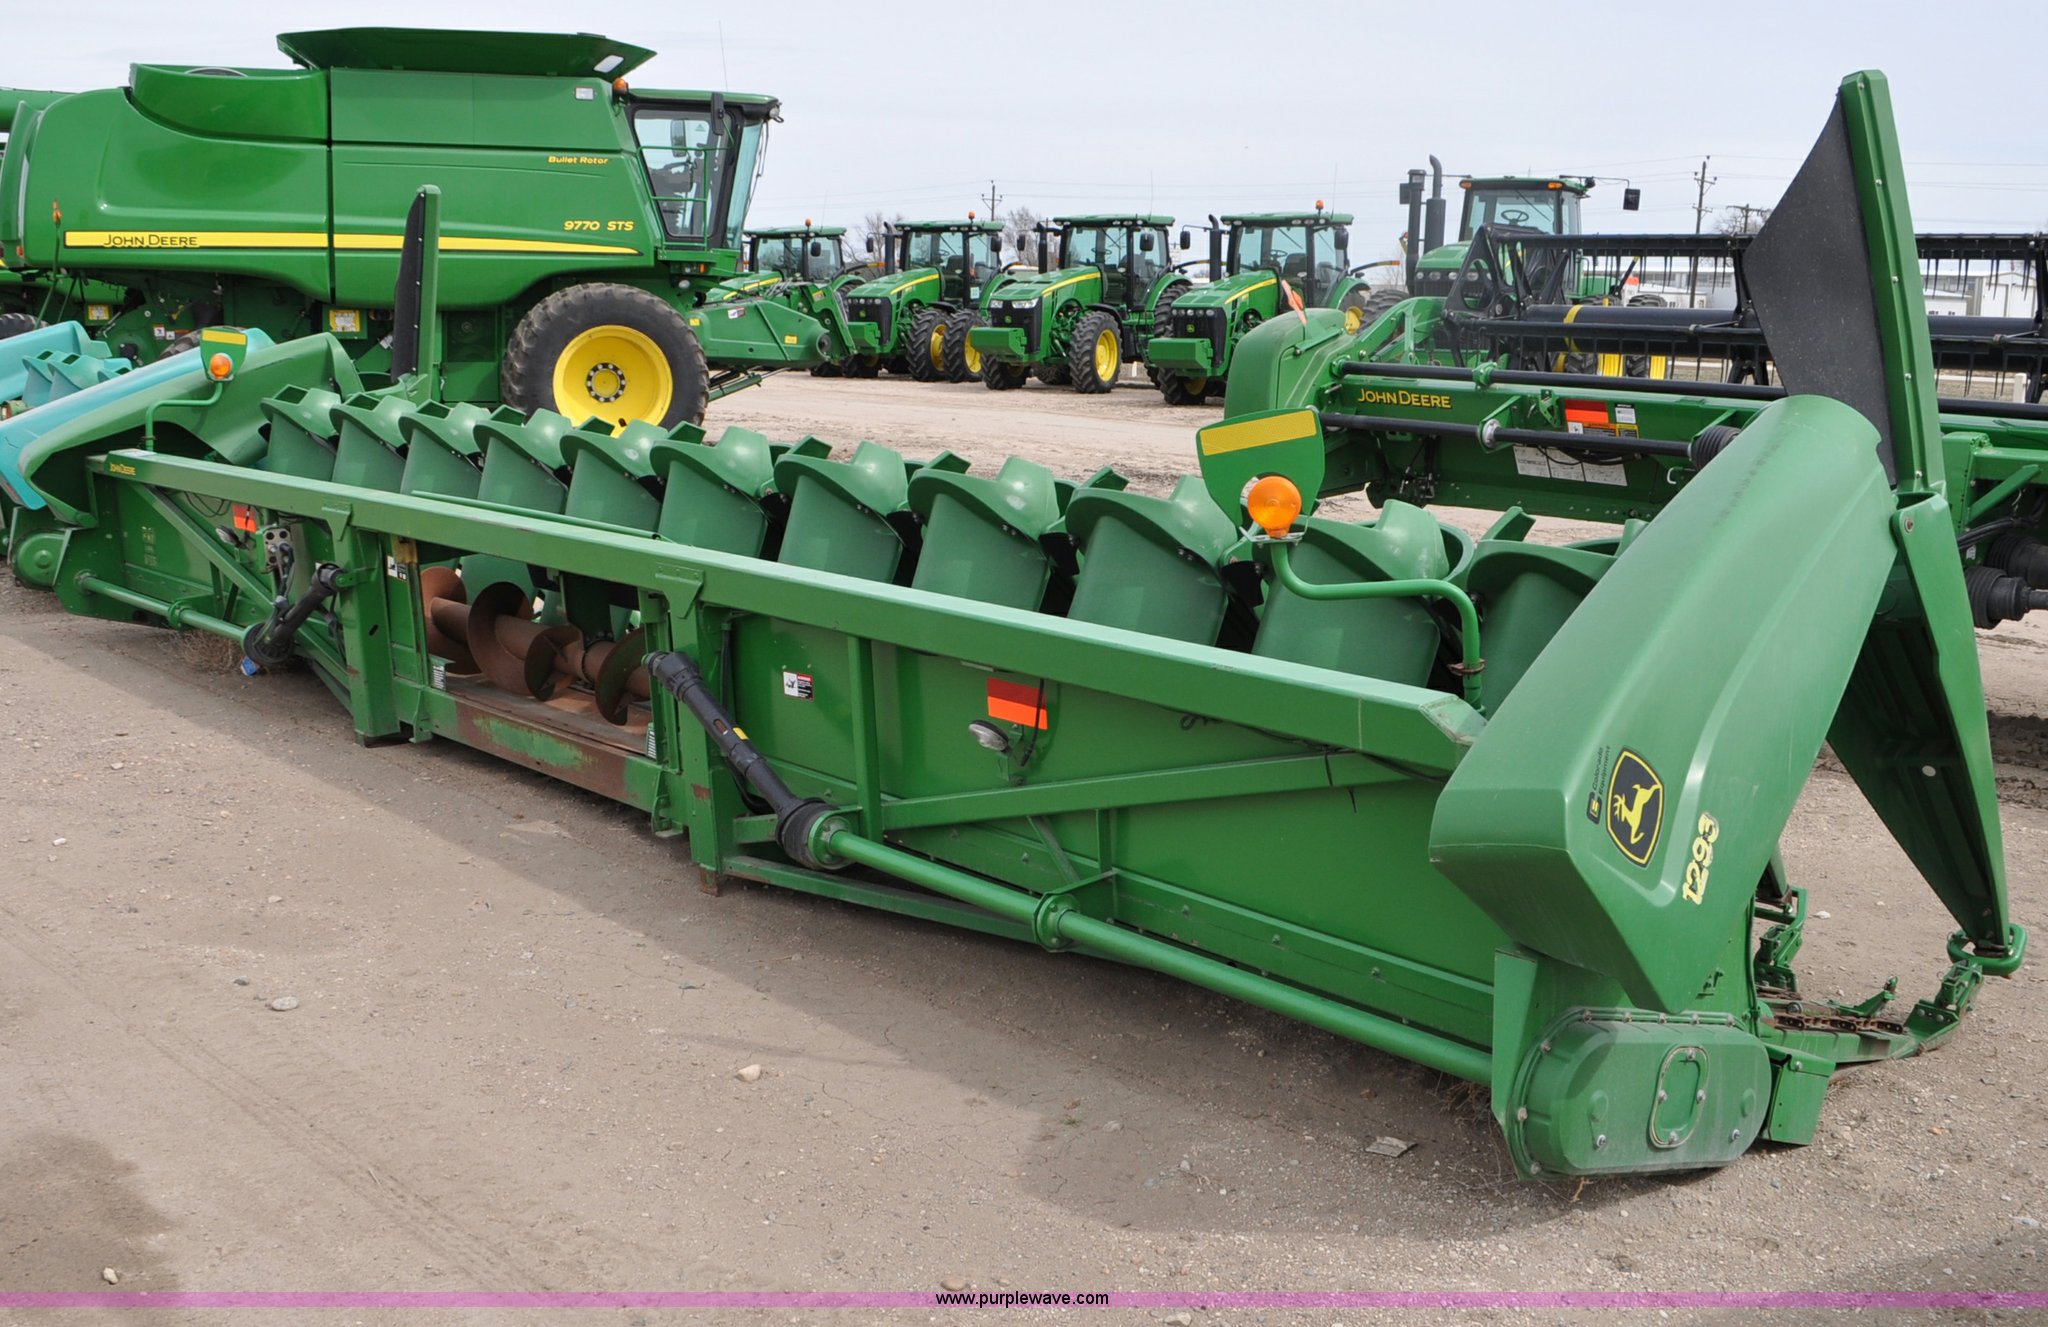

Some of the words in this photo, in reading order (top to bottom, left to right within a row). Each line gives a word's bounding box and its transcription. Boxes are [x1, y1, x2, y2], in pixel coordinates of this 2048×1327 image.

[548, 156, 577, 164] Bullet
[579, 156, 608, 165] Rotor
[564, 221, 601, 231] 9770
[607, 221, 634, 232] STS
[103, 234, 145, 246] JOHN
[148, 234, 198, 246] DEERE
[1358, 388, 1397, 404] JOHN
[1398, 390, 1451, 409] DEERE
[1592, 747, 1604, 791] Colorado
[1598, 745, 1611, 795] Equipment
[1682, 812, 1719, 905] 1293
